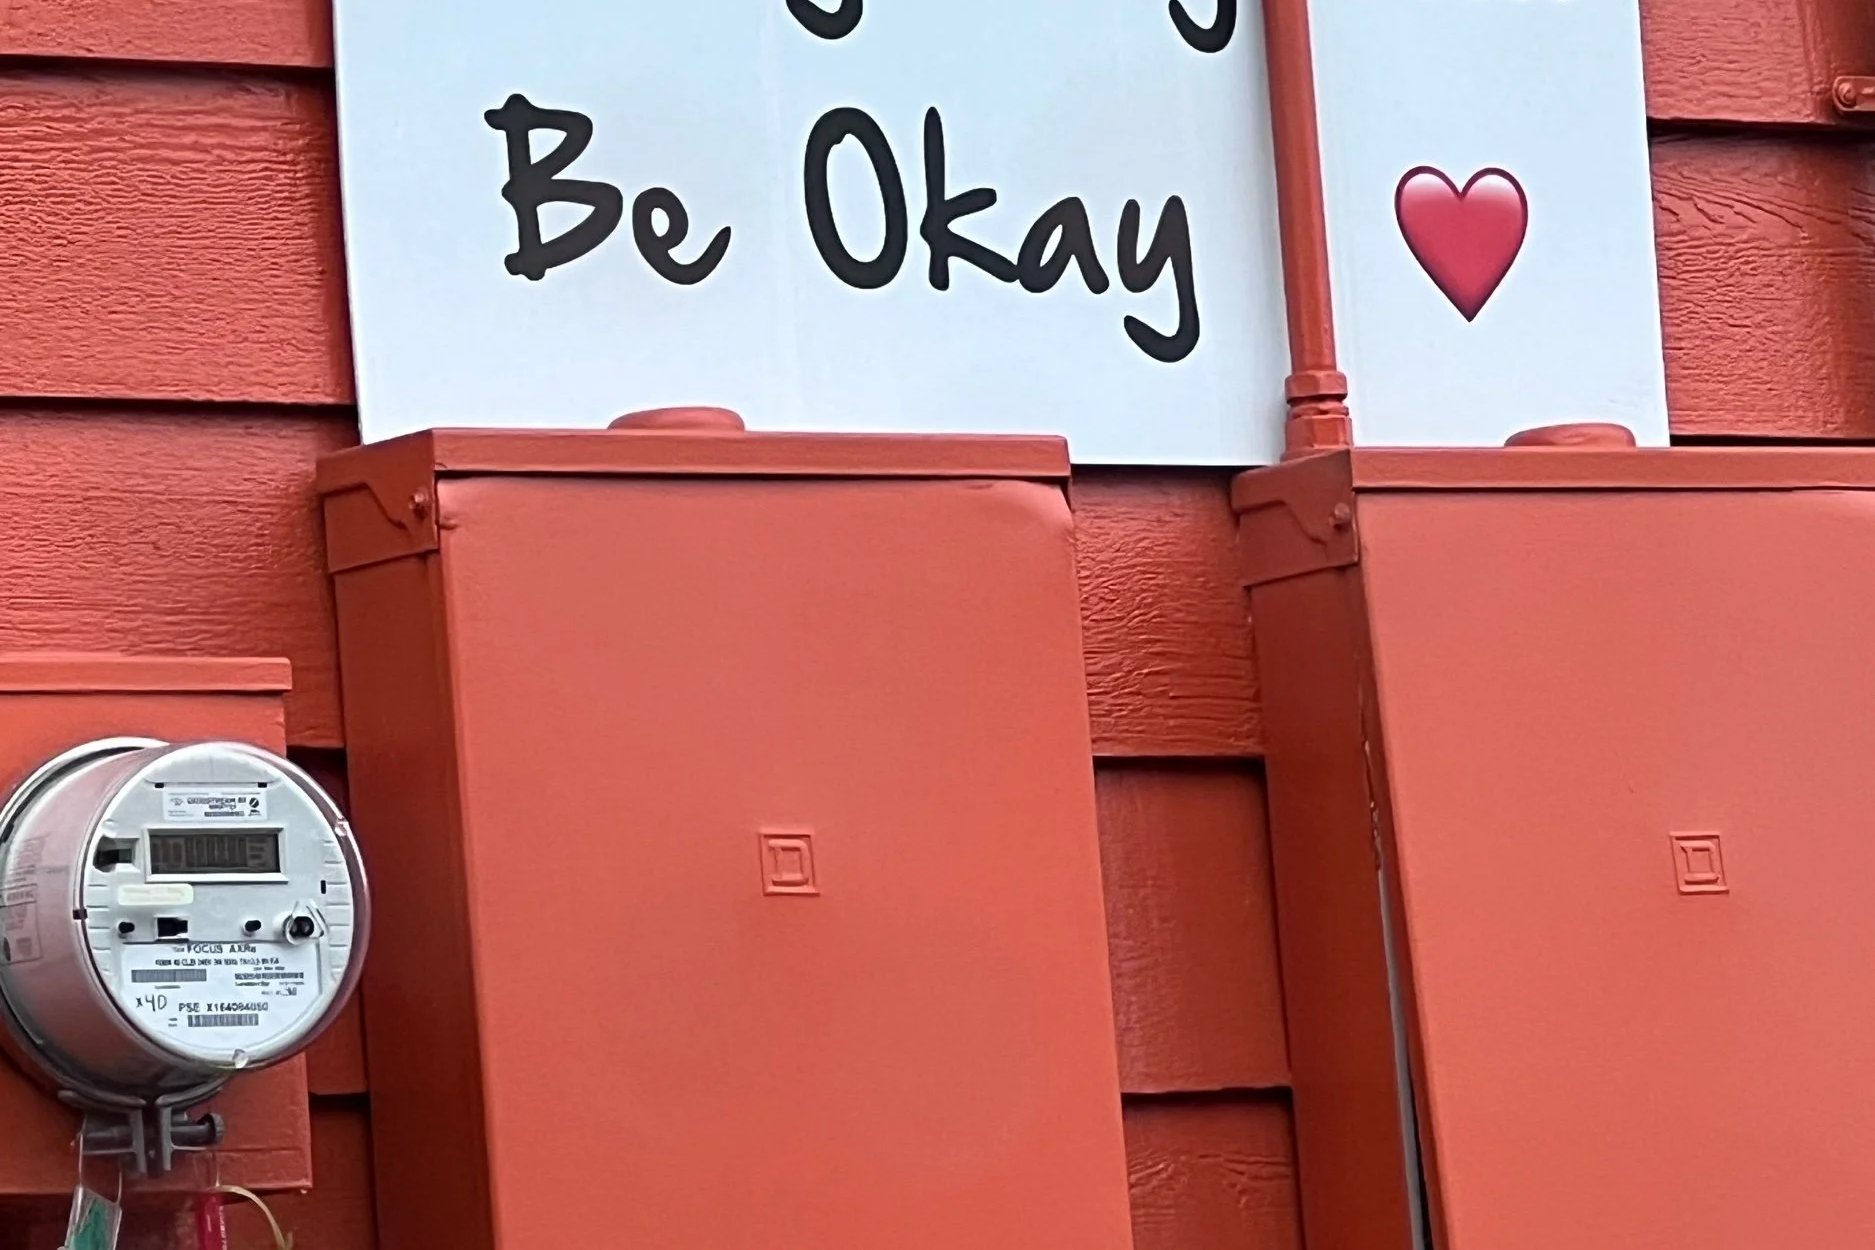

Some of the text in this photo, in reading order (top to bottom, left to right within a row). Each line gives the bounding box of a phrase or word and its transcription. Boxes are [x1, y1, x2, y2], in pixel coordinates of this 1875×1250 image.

[483, 93, 1200, 363] Be Okay
[178, 1002, 201, 1013] PSE
